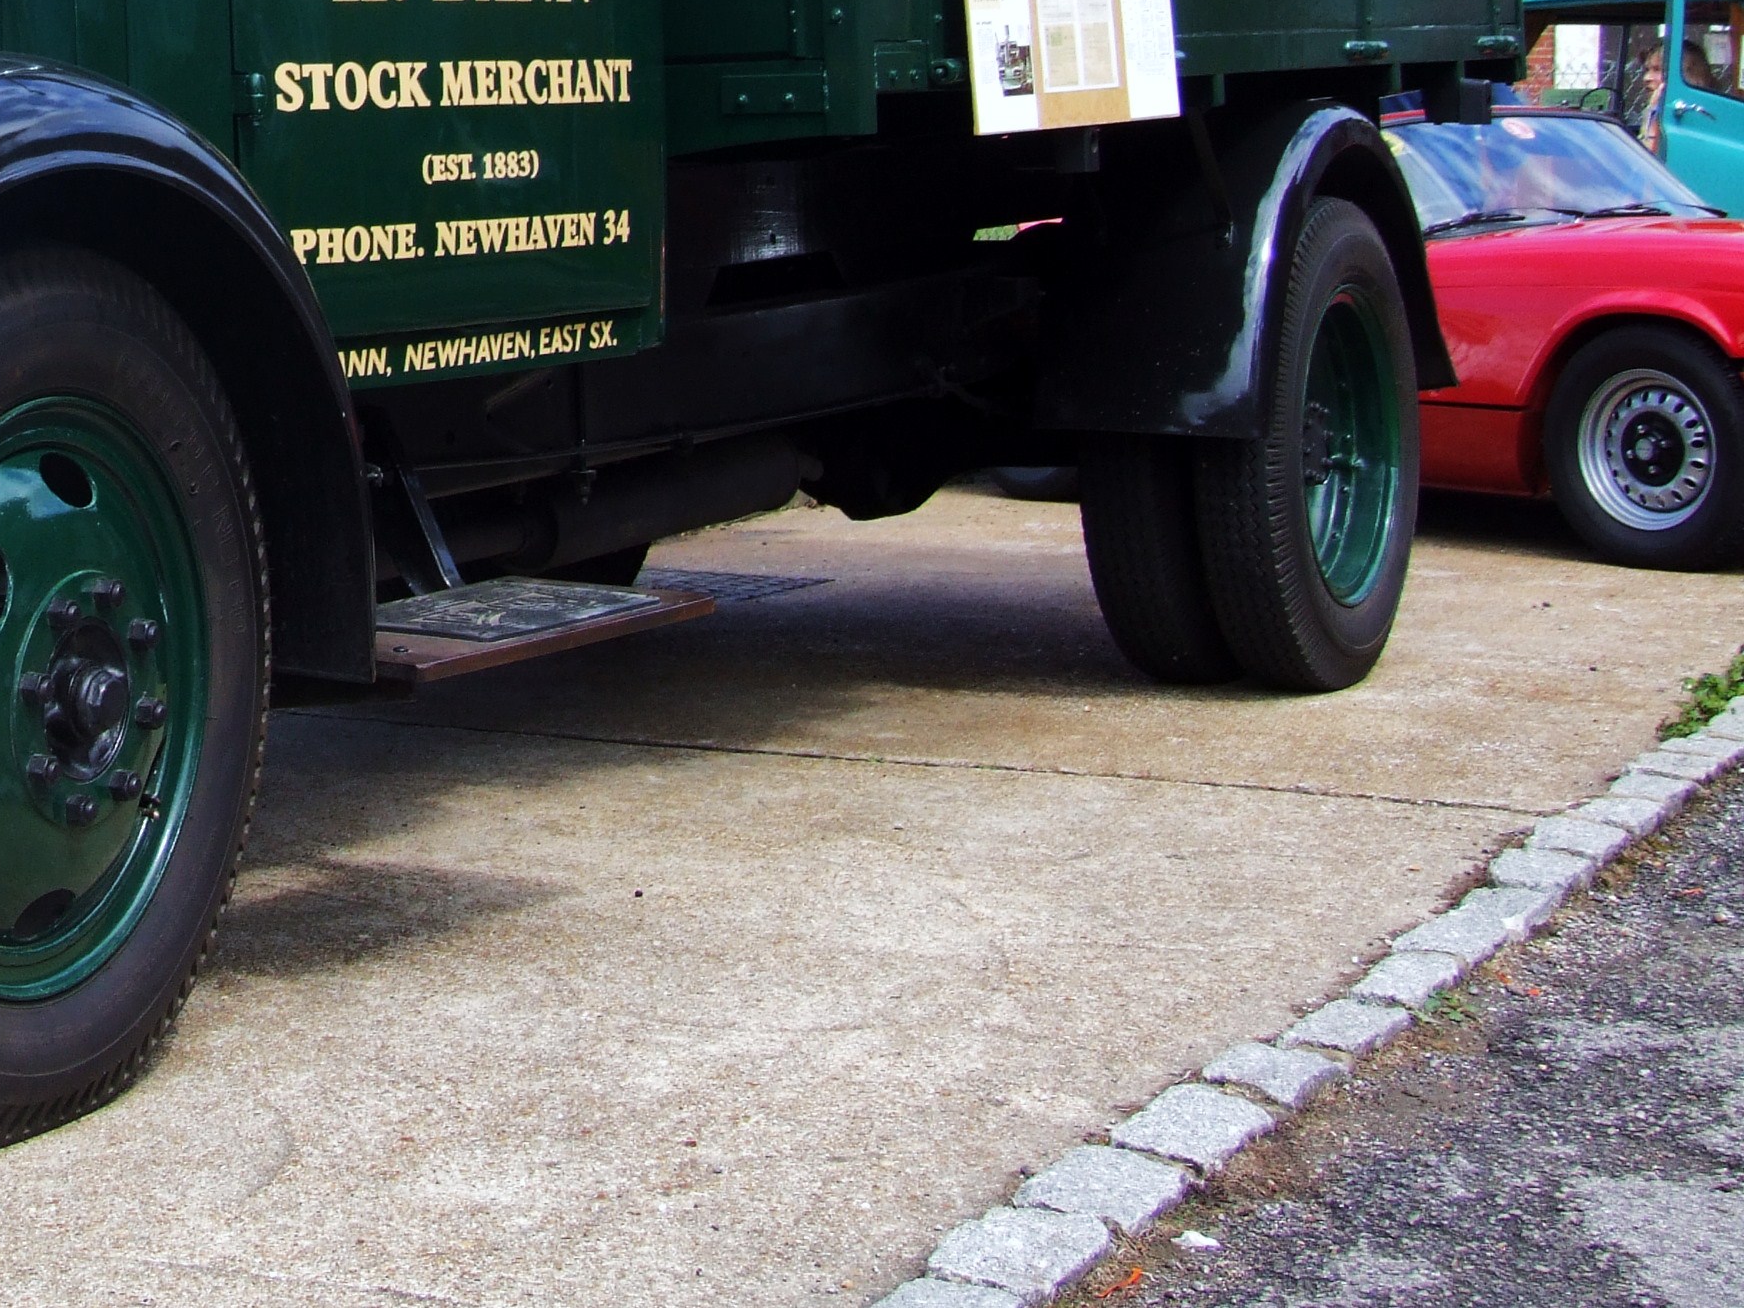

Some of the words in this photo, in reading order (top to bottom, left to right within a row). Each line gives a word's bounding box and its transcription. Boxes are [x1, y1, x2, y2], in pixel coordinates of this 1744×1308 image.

[274, 61, 431, 112] STOCK
[440, 59, 632, 107] MERCHANT
[422, 154, 477, 185] (EST.
[483, 150, 540, 180] 1883)
[289, 222, 425, 265] PHONE.
[434, 211, 596, 257] NEWHAVEN
[603, 209, 631, 245] 34
[403, 330, 536, 373] NEWHAVEN,
[539, 323, 586, 355] EAST
[589, 320, 618, 350] SX.
